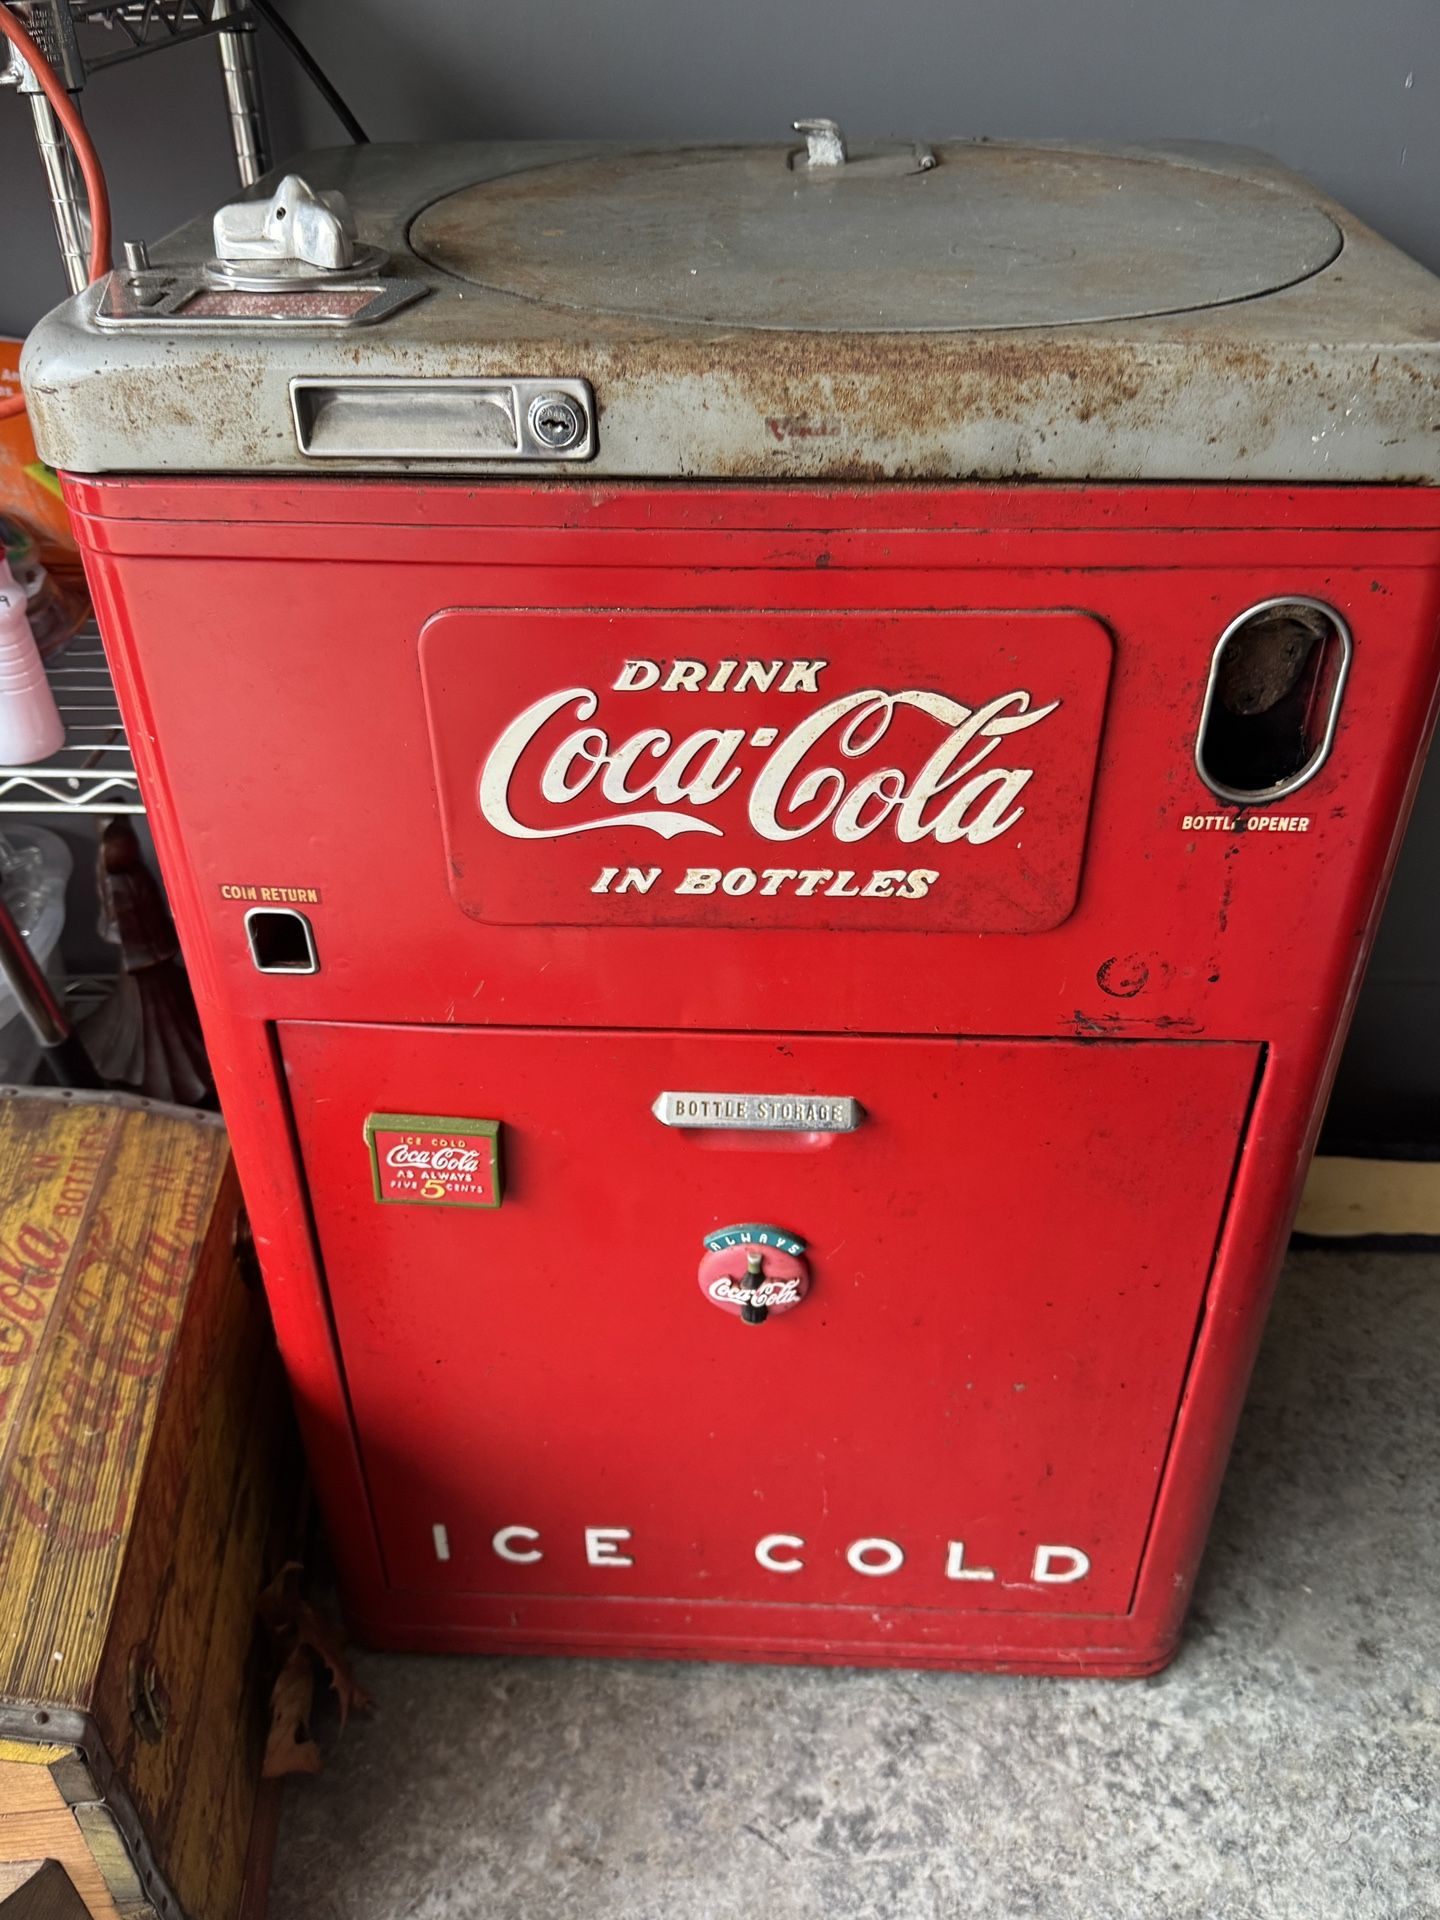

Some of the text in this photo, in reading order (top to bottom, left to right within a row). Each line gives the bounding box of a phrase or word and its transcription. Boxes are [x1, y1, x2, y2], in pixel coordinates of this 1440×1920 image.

[613, 660, 828, 694] DRINK
[479, 687, 1061, 845] Coca-Cola
[1182, 815, 1310, 832] BOTTL OPENER
[221, 885, 319, 903] COIN RETURN
[591, 867, 941, 900] IN BOTTLES
[675, 1100, 844, 1122] BOTTLE STORAGE
[400, 1135, 467, 1148] ICE COLD
[386, 1144, 480, 1172] Coca-Cola
[397, 1170, 472, 1182] AS ALWAYS
[390, 1180, 483, 1199] FIVE 5 CENTS
[710, 1232, 800, 1255] ALWAYS
[708, 1277, 801, 1308] Coca-Cola
[433, 1523, 1091, 1584] ICE COLD
